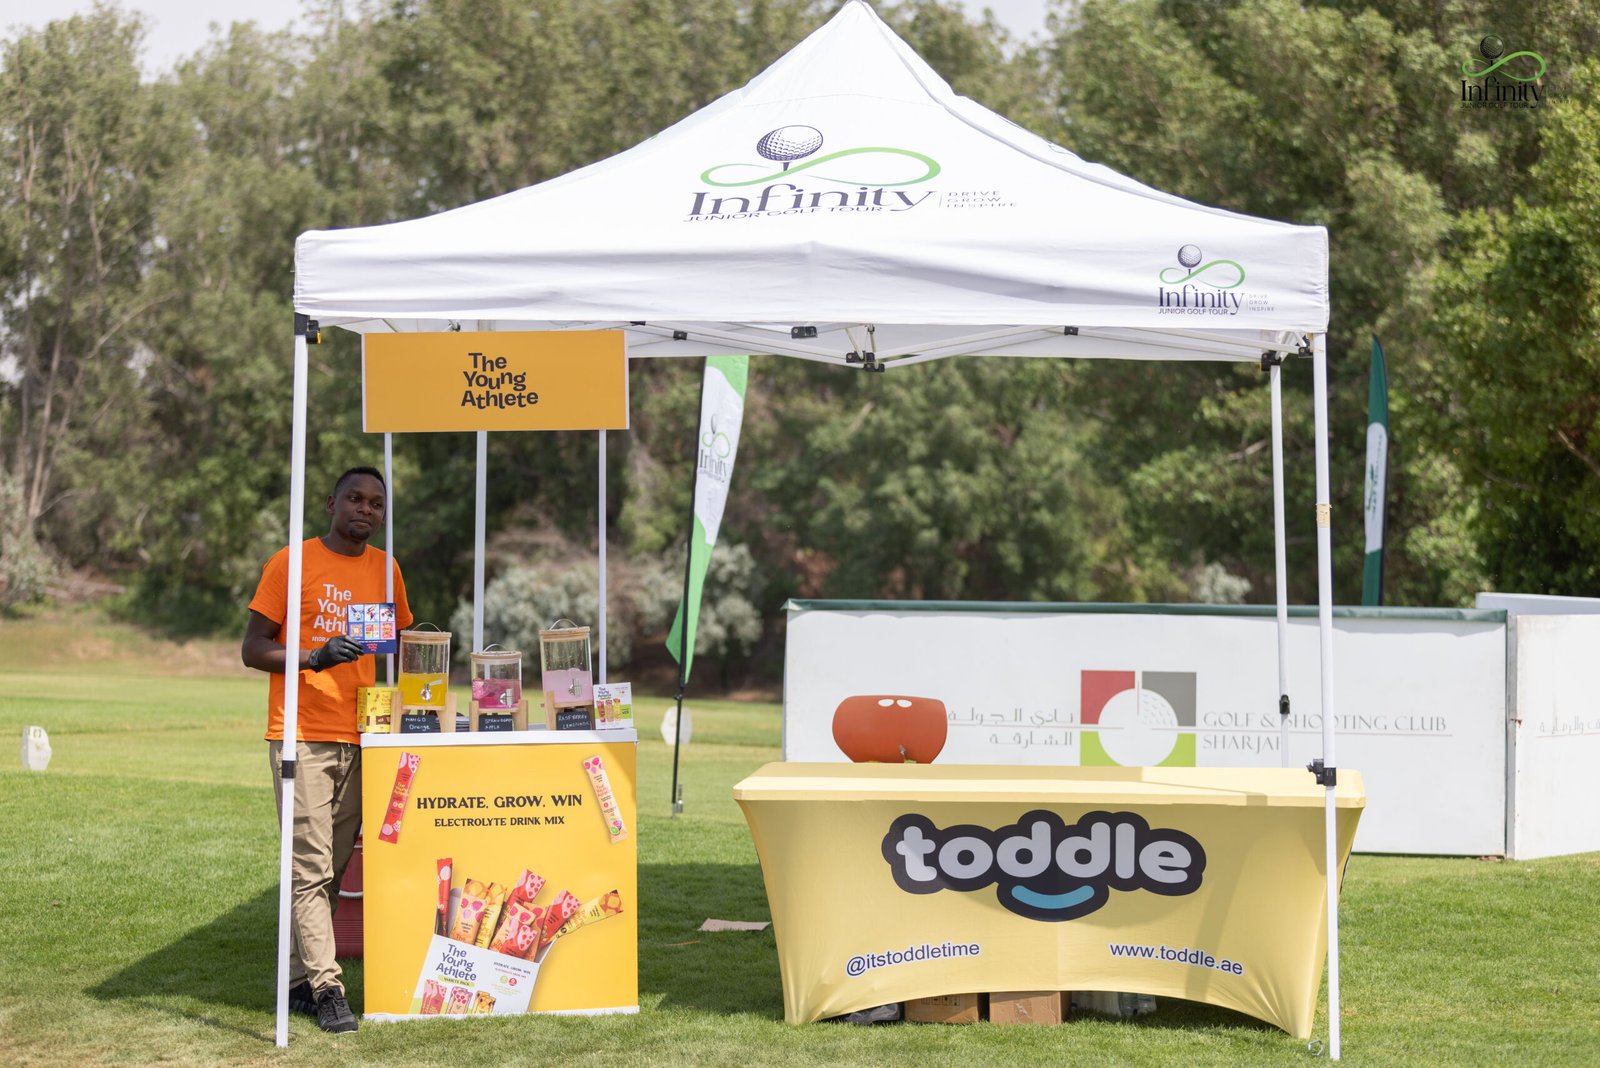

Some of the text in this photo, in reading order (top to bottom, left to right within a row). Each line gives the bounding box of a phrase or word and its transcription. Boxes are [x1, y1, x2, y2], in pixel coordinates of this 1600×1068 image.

[687, 183, 936, 217] Infinity
[683, 212, 760, 223] JUNIOR
[766, 208, 815, 217] GOLF
[1158, 284, 1245, 316] Infinity
[468, 352, 507, 372] The
[463, 370, 527, 392] Young
[460, 390, 539, 410] Athlete
[322, 583, 352, 602] The
[316, 598, 347, 618] You
[313, 614, 347, 635] Athl
[1203, 711, 1255, 728] GOLF
[1260, 712, 1276, 728] &
[1394, 715, 1446, 731] CLUB
[989, 730, 1073, 749] الشارقة
[551, 794, 583, 807] WIN
[434, 816, 565, 827] ELECTROLYTE DRINK MIX
[896, 820, 1192, 885] toddle
[448, 943, 467, 958] The
[846, 942, 981, 977] @itstoddletime
[1110, 944, 1243, 975] www.toddle.ae
[436, 963, 477, 981] Athlete
[441, 952, 475, 972] Young
